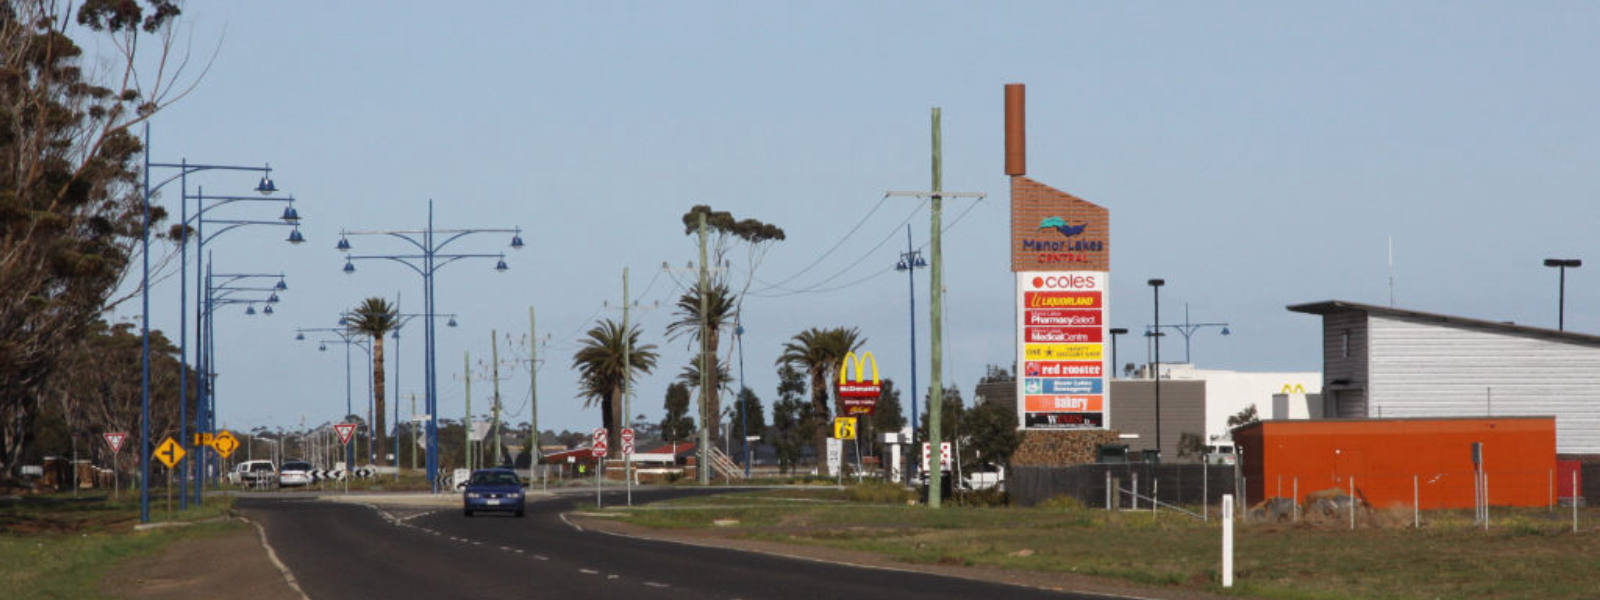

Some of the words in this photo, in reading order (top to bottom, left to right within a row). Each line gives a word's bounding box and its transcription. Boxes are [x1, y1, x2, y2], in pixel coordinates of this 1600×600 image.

[1023, 239, 1064, 251] Manor
[1068, 239, 1103, 251] Lakes
[1038, 253, 1089, 263] CENTRAL
[1045, 274, 1095, 288] coles
[1042, 297, 1094, 306] LIQUORLAND
[1042, 364, 1060, 374] red
[1062, 366, 1100, 374] rooster
[1054, 397, 1089, 411] bakery
